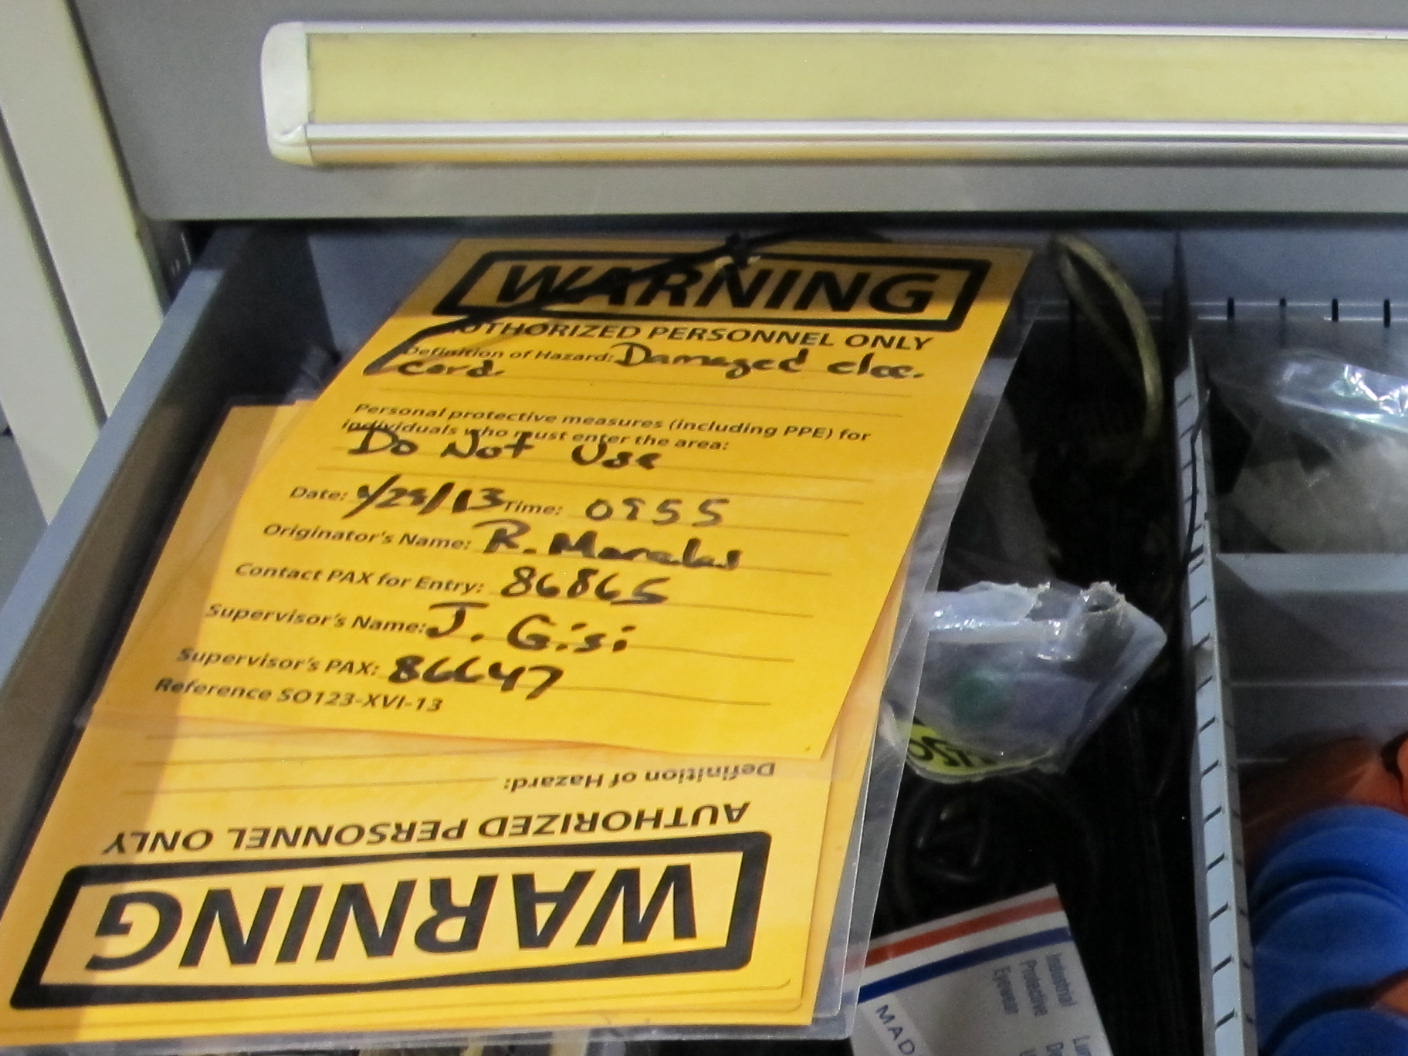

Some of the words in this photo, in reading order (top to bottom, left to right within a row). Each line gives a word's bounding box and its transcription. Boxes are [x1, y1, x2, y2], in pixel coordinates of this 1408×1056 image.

[496, 264, 940, 314] WARNING
[447, 319, 642, 339] UTHORIZED
[647, 326, 835, 347] PERSONNEL
[844, 334, 934, 350] ONLY
[510, 349, 533, 360] of
[534, 349, 615, 363] Hazard:
[342, 419, 458, 436] individuals
[464, 425, 507, 438] who
[514, 430, 567, 442] must
[571, 433, 630, 446] enter
[633, 434, 670, 447] the
[675, 437, 729, 450] area:
[354, 403, 447, 418] Personal
[448, 409, 561, 424] protective
[562, 416, 664, 430] measures
[669, 418, 778, 438] (including
[783, 425, 834, 441] PPE)
[838, 428, 872, 442] for
[347, 425, 418, 455] Do
[440, 428, 535, 459] Not
[571, 438, 663, 469] Use
[289, 486, 348, 501] Date:
[504, 501, 563, 516] Time:
[263, 523, 393, 544] Originator's
[398, 533, 472, 550] Name:
[235, 563, 322, 582] Contact
[326, 570, 373, 585] PAX
[376, 572, 413, 588] for
[415, 577, 485, 595] Entry:
[205, 603, 346, 628] Supervisor's
[351, 615, 427, 634] Name:
[176, 648, 320, 672] Supervisor's
[325, 660, 380, 676] PAX:
[154, 677, 272, 701] Reference
[503, 773, 604, 792] Hazard:
[609, 772, 637, 788] of
[644, 762, 777, 784] Definition
[478, 800, 752, 838] AUTHORIZED
[102, 829, 215, 855] ONLY
[227, 818, 468, 850] PERSONNEL
[85, 862, 699, 971] WARNING
